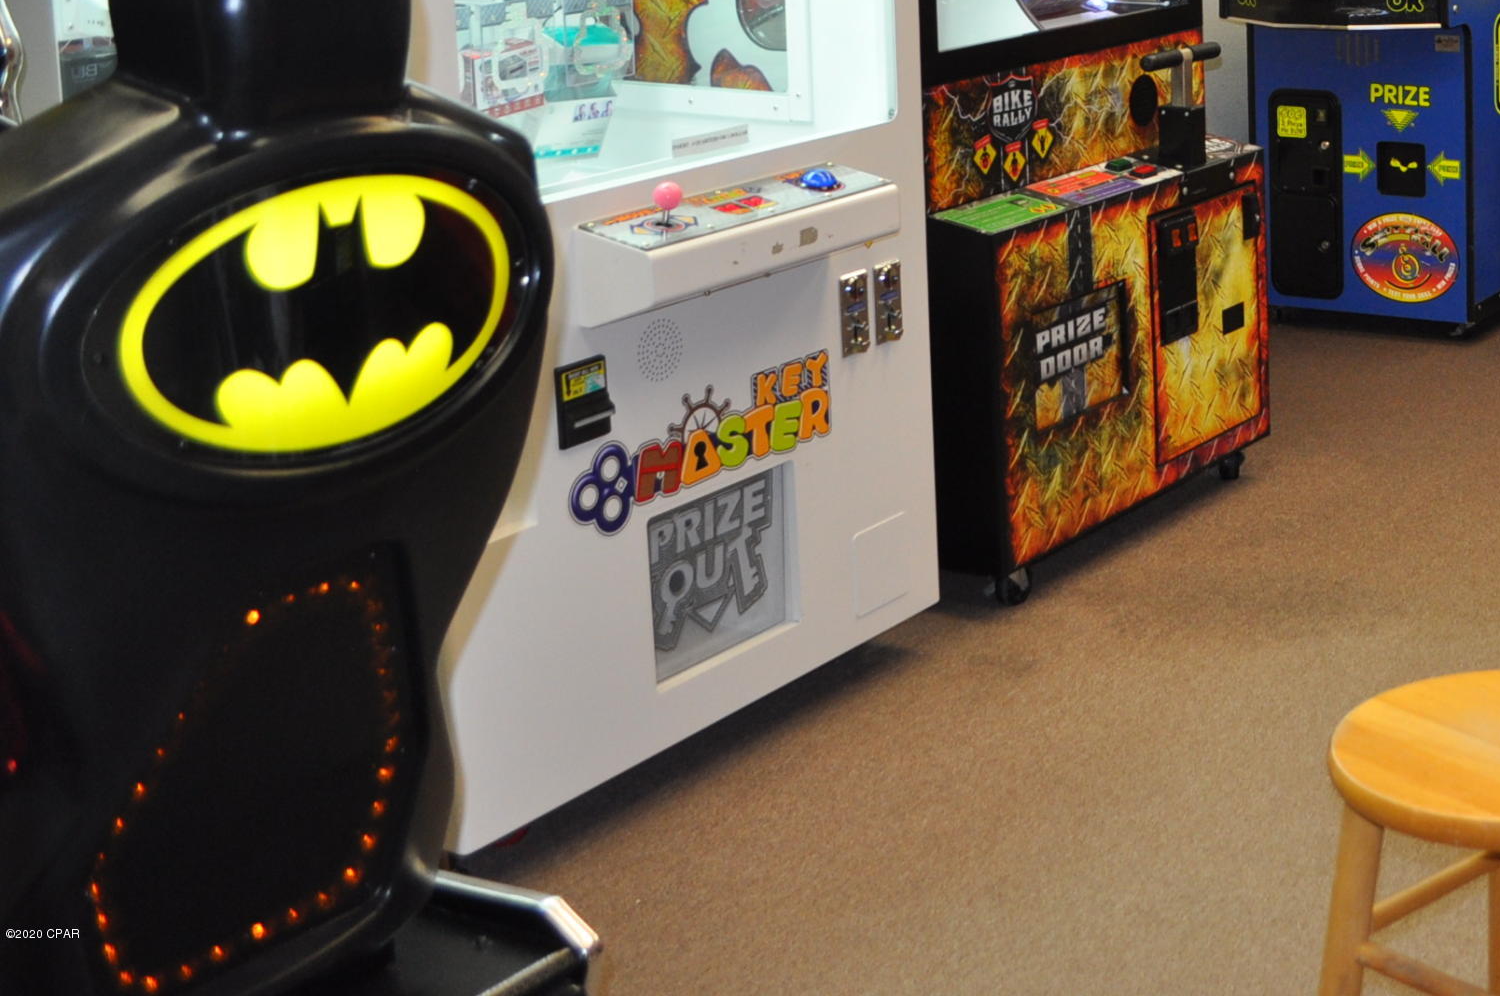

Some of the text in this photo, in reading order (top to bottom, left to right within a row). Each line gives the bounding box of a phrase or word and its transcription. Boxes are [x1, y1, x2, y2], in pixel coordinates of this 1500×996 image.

[992, 88, 1034, 114] BIKE
[992, 106, 1033, 128] RALLY
[1369, 82, 1431, 107] PRIZE
[1035, 306, 1108, 355] PRIZE
[756, 350, 829, 406] KEY
[1038, 335, 1105, 383] DOOR
[634, 387, 831, 504] MASTER
[651, 479, 767, 564] PRIZE
